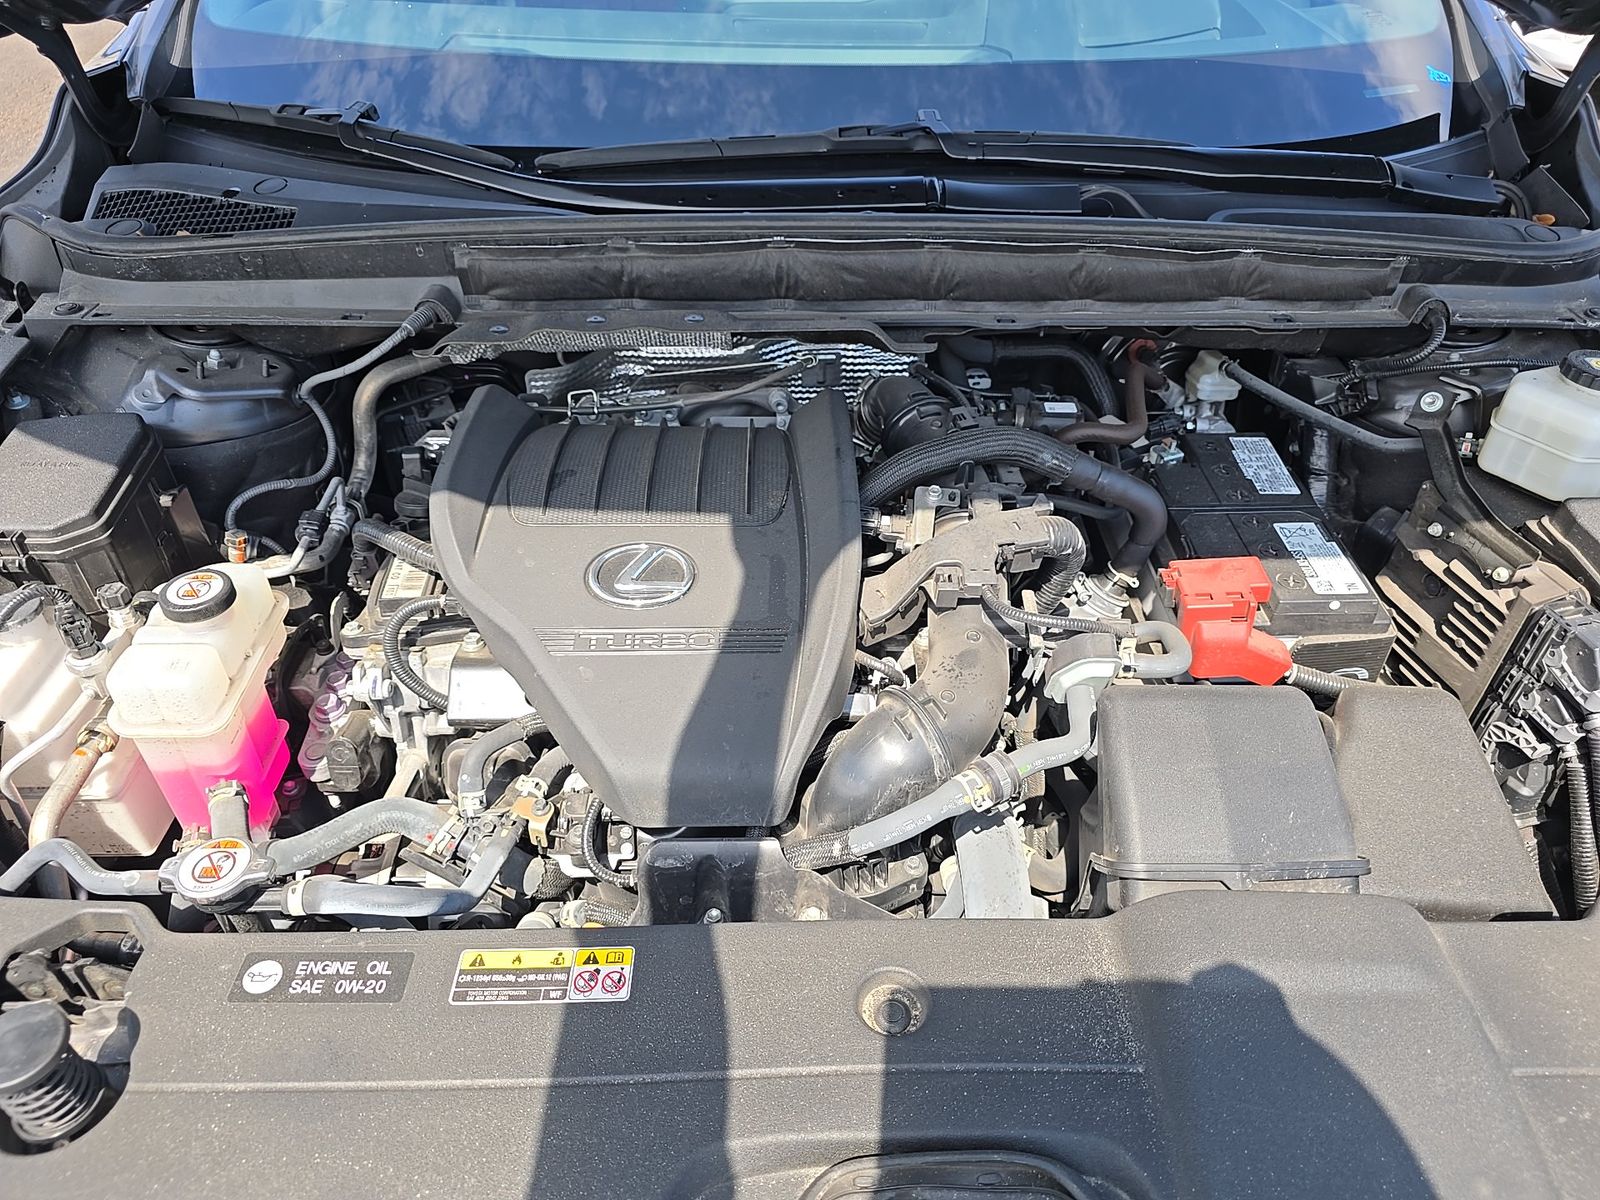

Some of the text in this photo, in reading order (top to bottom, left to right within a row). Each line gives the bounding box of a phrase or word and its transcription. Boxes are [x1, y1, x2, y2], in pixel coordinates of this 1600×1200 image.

[579, 633, 716, 650] TURBO
[295, 960, 393, 975] ENGINE OIL
[289, 979, 387, 994] SAE 0W-20
